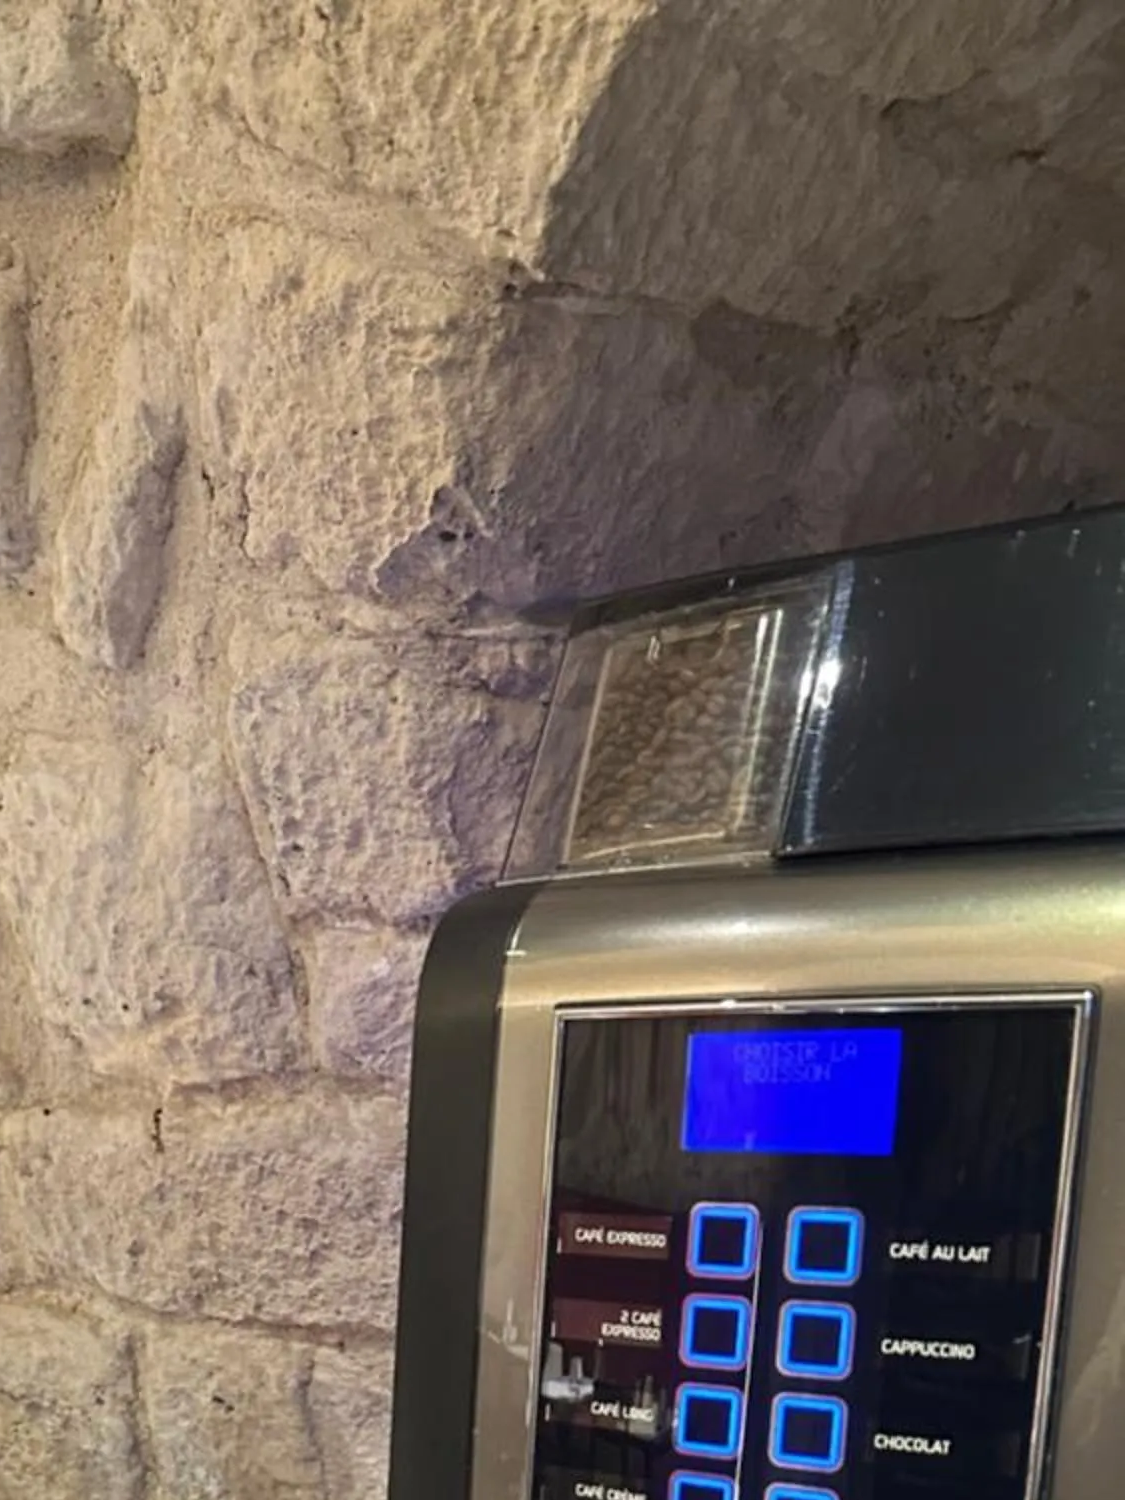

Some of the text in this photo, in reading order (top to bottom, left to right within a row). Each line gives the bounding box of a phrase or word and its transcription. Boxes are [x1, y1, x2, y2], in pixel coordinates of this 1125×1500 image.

[575, 1226, 605, 1244] CAFÉ
[889, 1239, 991, 1263] CAFÉ AU LAIT
[619, 1308, 662, 1327] 2 CAFÉ
[880, 1338, 976, 1360] CAPPUCCINO
[590, 1400, 620, 1418] CAFÉ
[873, 1433, 953, 1455] CHOCOLAT
[575, 1482, 604, 1500] CAFÉ
